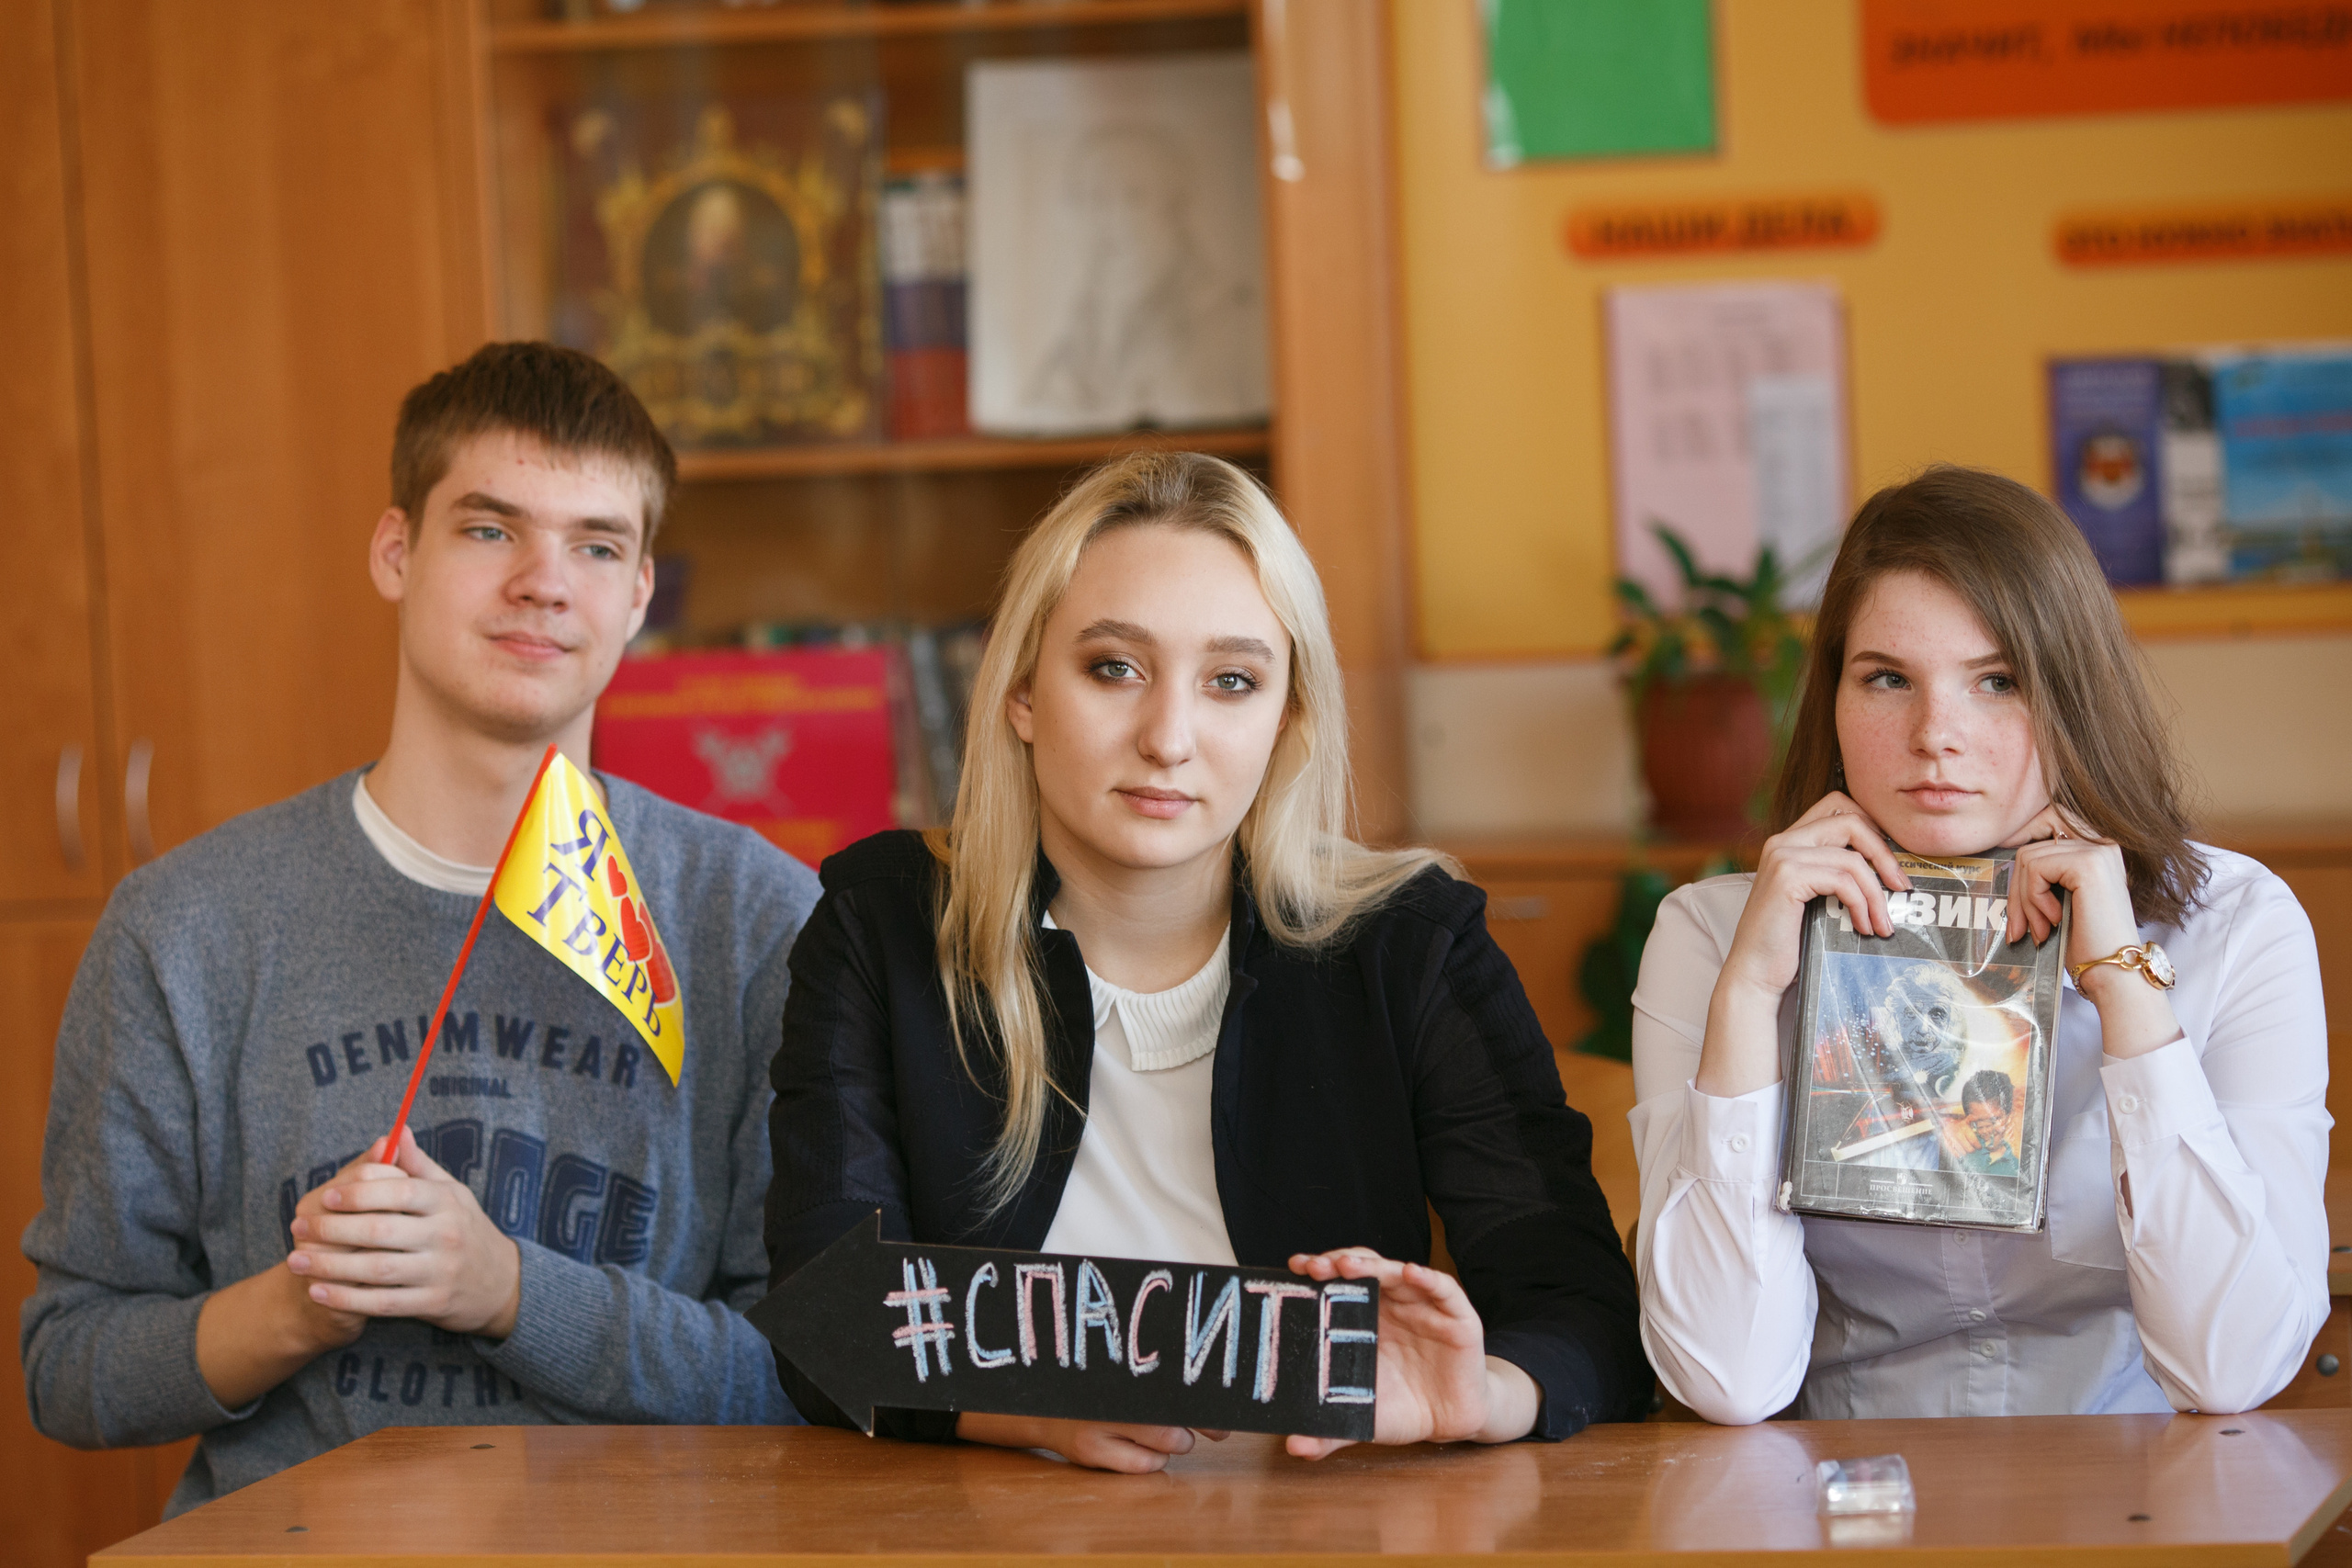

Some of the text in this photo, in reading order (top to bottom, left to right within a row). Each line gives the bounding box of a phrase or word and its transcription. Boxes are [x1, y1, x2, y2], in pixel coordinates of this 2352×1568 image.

[549, 809, 611, 882] Я
[1897, 860, 1954, 872] ссический
[526, 862, 662, 1038] ТВЕРЬ
[1869, 1183, 1933, 1195] ПРОСВЕЩЕНИЕ
[882, 1257, 1376, 1406] #СПАСИТЕ
